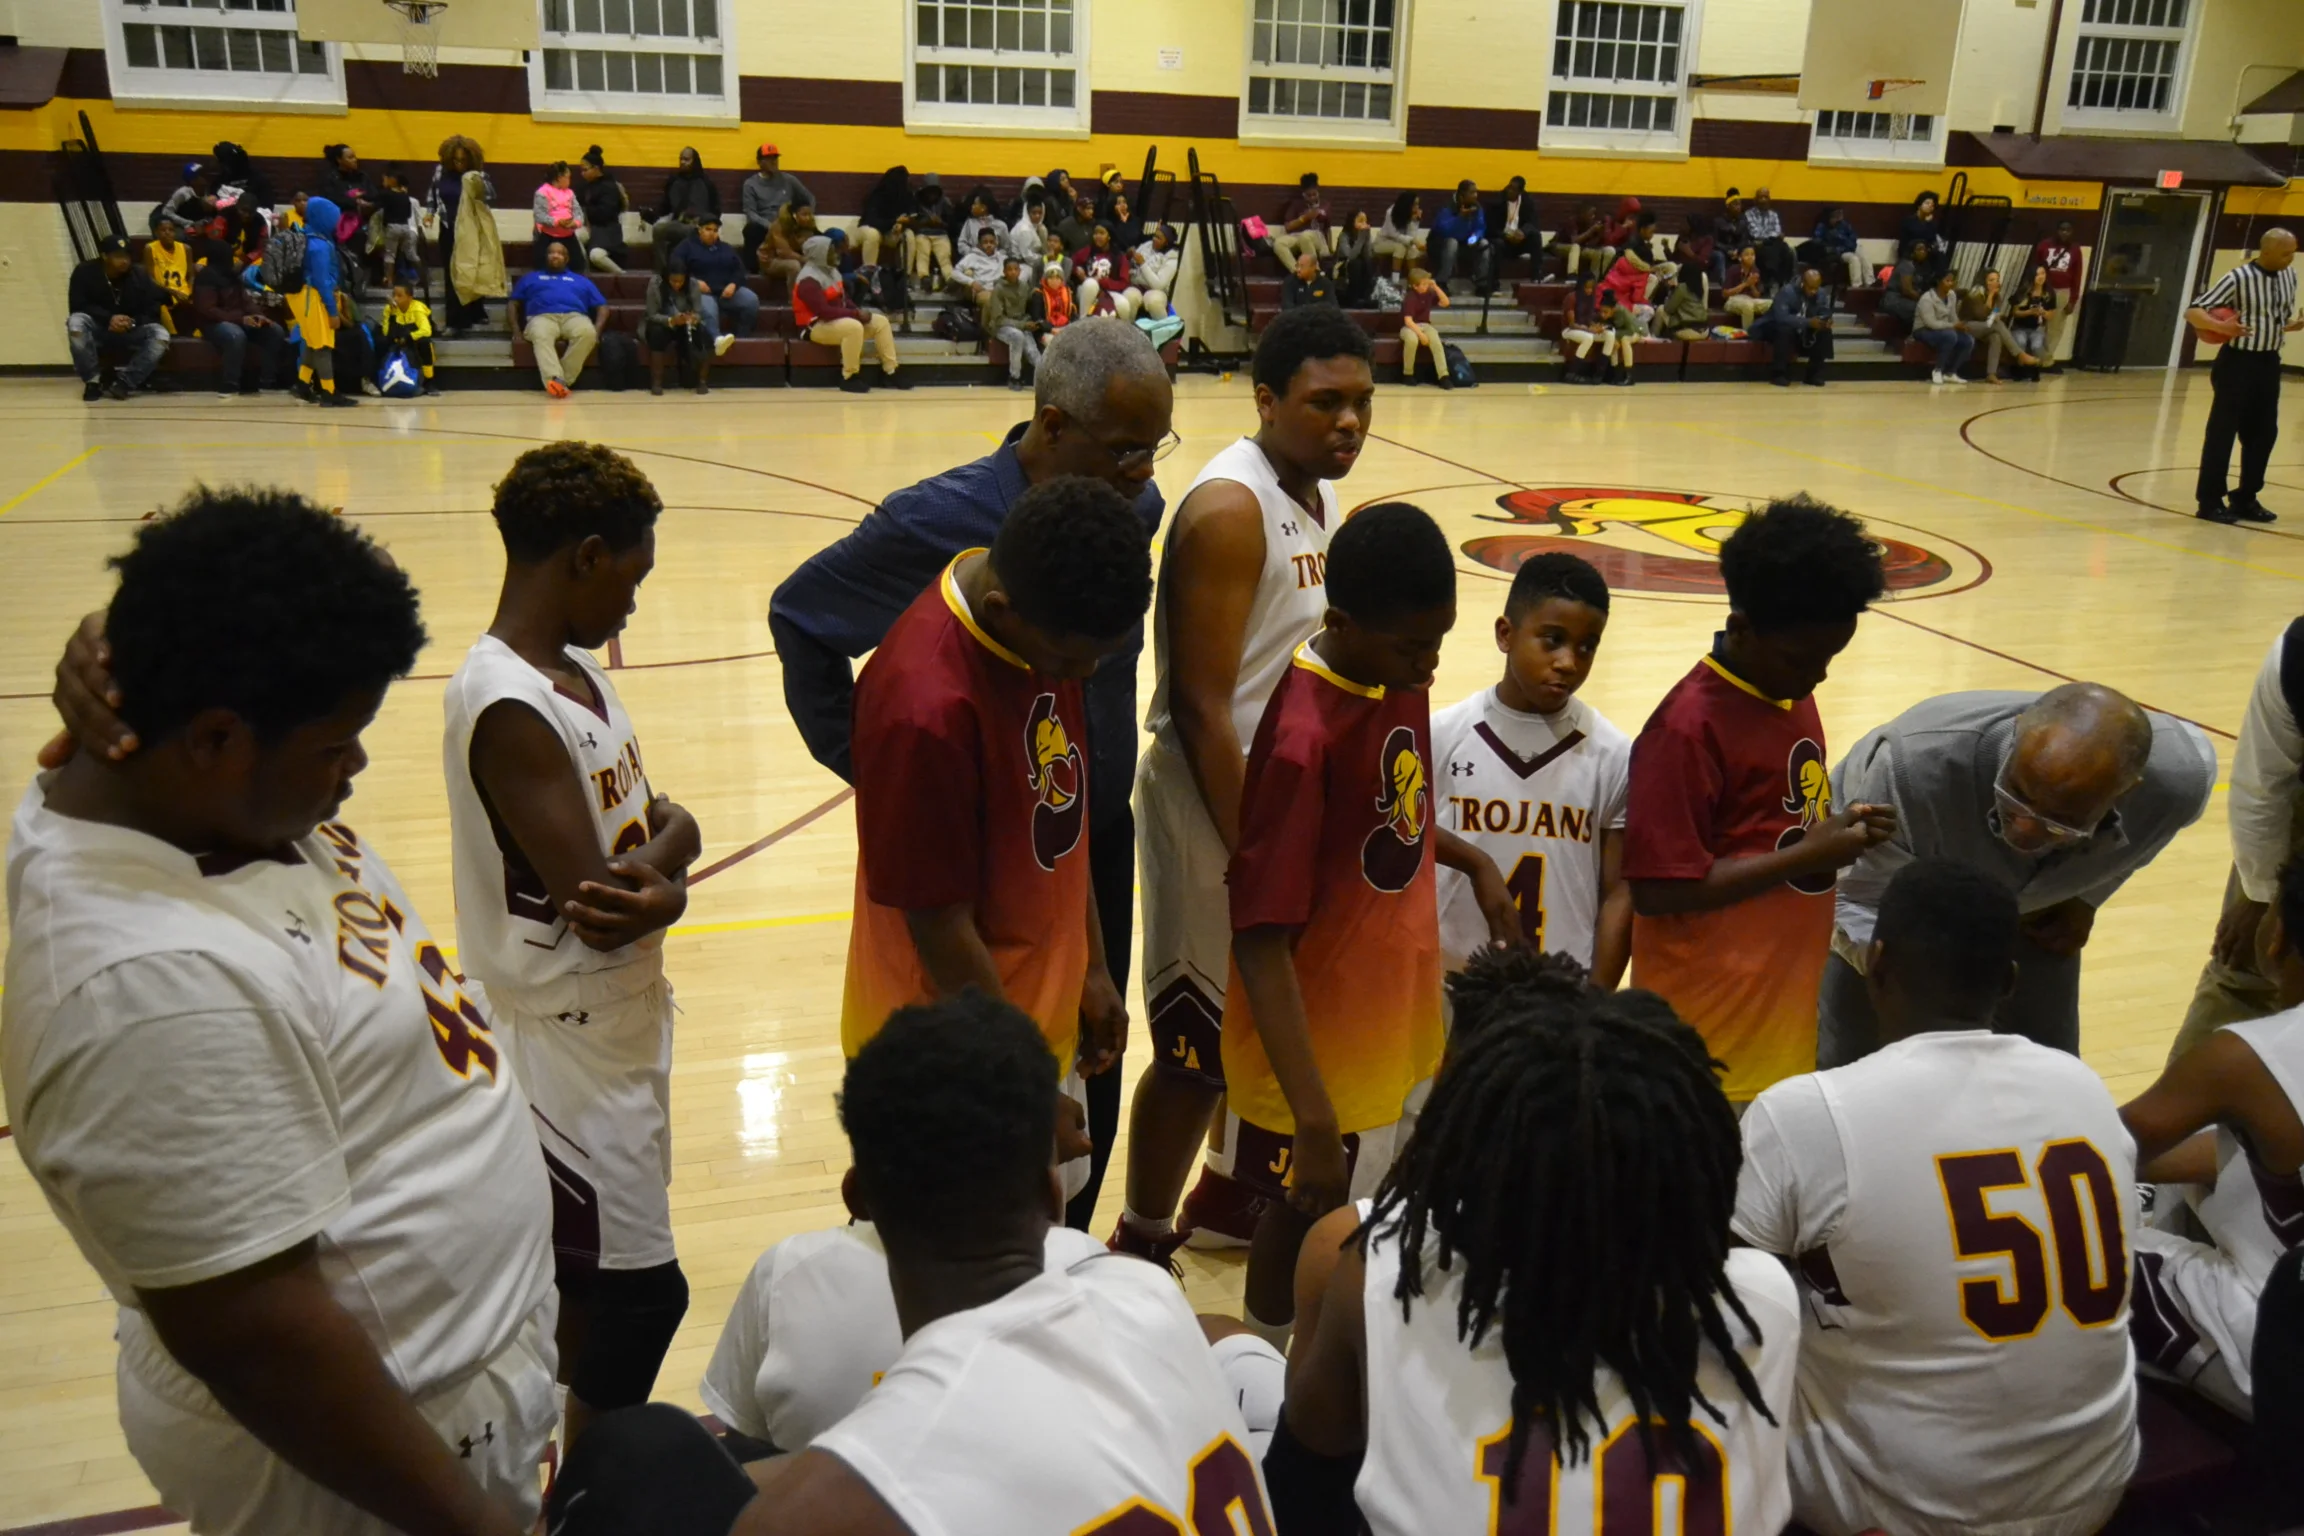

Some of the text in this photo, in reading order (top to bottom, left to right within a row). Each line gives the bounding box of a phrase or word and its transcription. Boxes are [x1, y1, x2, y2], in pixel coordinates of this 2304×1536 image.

[1291, 551, 1328, 590] TRO
[1449, 796, 1595, 844] TROJANS
[1505, 851, 1547, 955] 4
[1932, 1136, 2129, 1343] 50
